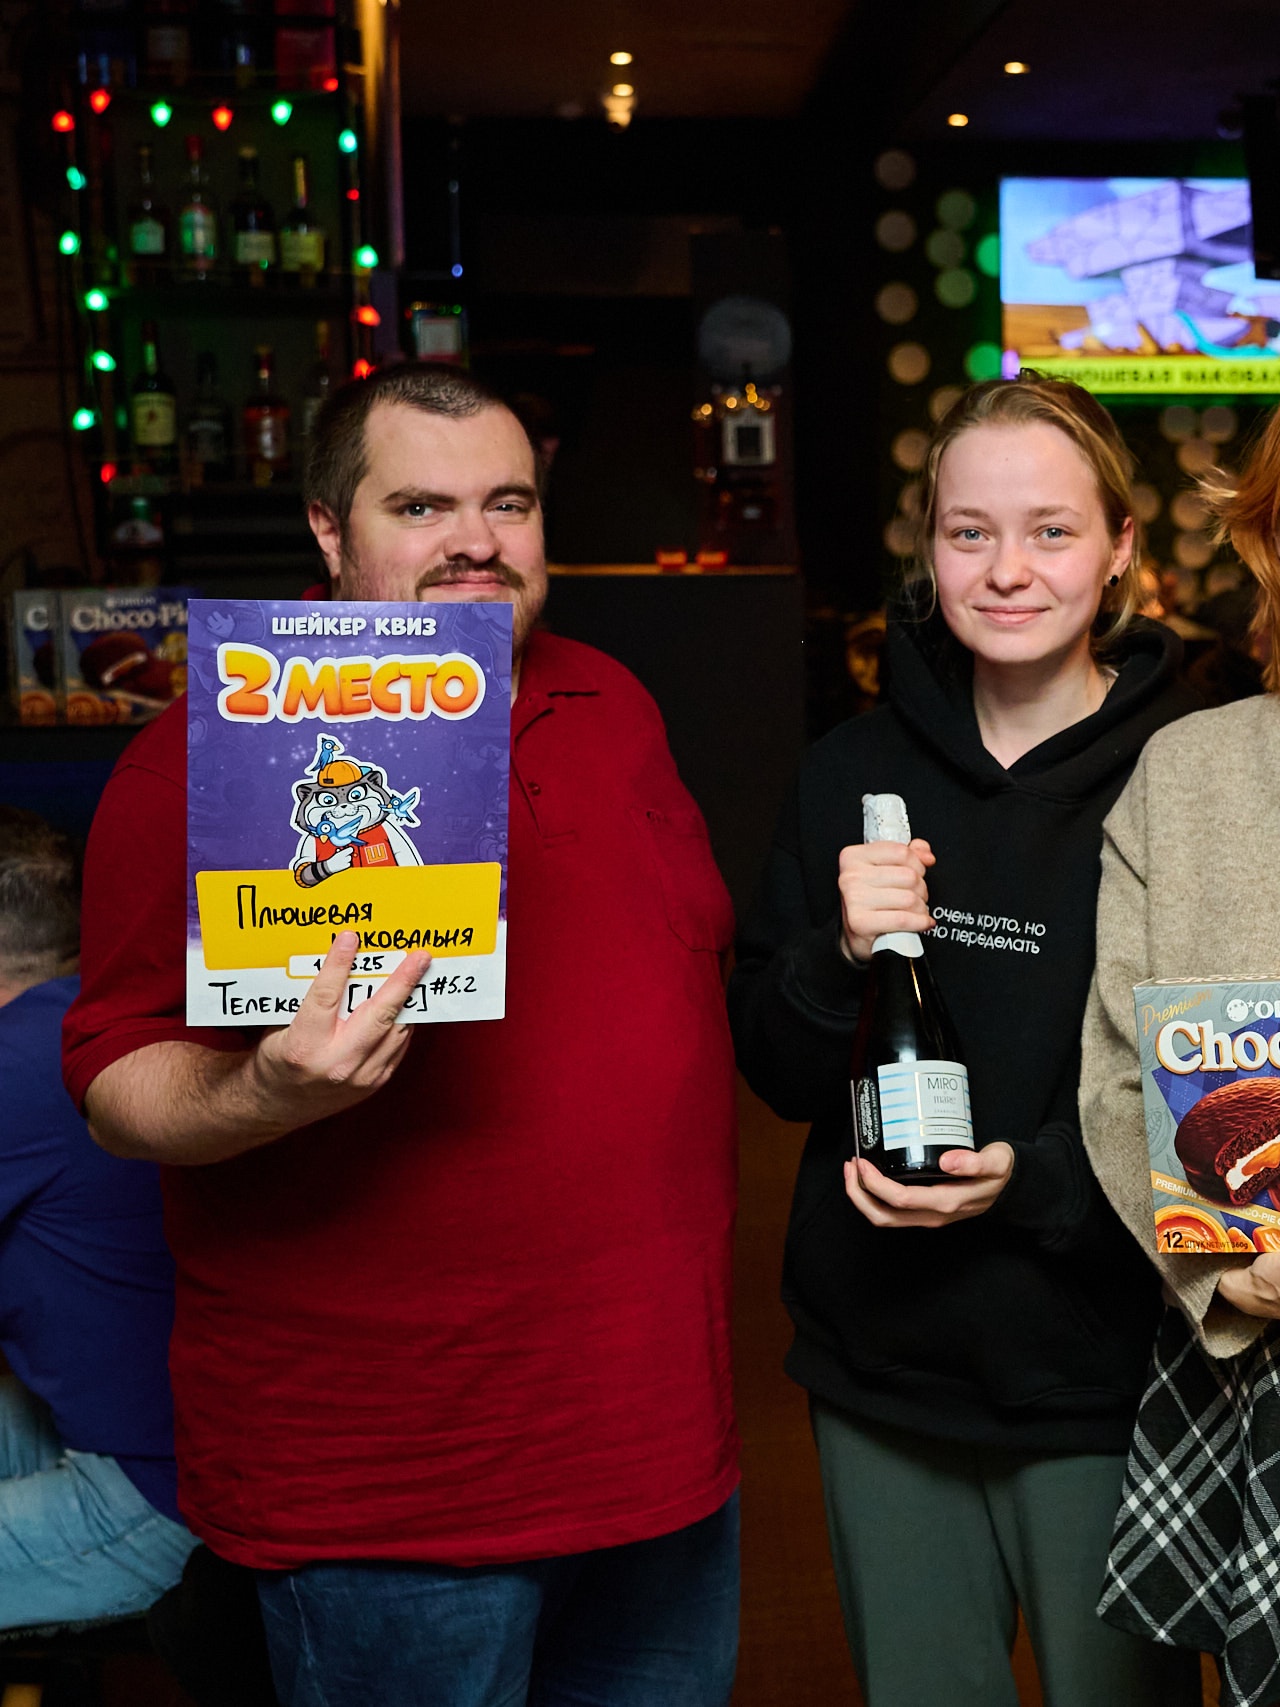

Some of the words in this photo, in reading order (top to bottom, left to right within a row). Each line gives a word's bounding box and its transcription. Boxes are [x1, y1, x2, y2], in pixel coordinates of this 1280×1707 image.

[271, 612, 367, 636] ШЕЙКЕР
[375, 617, 437, 636] КВИЗ
[222, 647, 274, 719] 2
[281, 657, 482, 719] МЕСТО
[932, 906, 975, 926] очень
[976, 913, 1021, 934] круто,
[1024, 921, 1047, 937] но
[950, 927, 1041, 955] переделать
[927, 1076, 958, 1091] MIRO
[1163, 1231, 1184, 1249] 12
